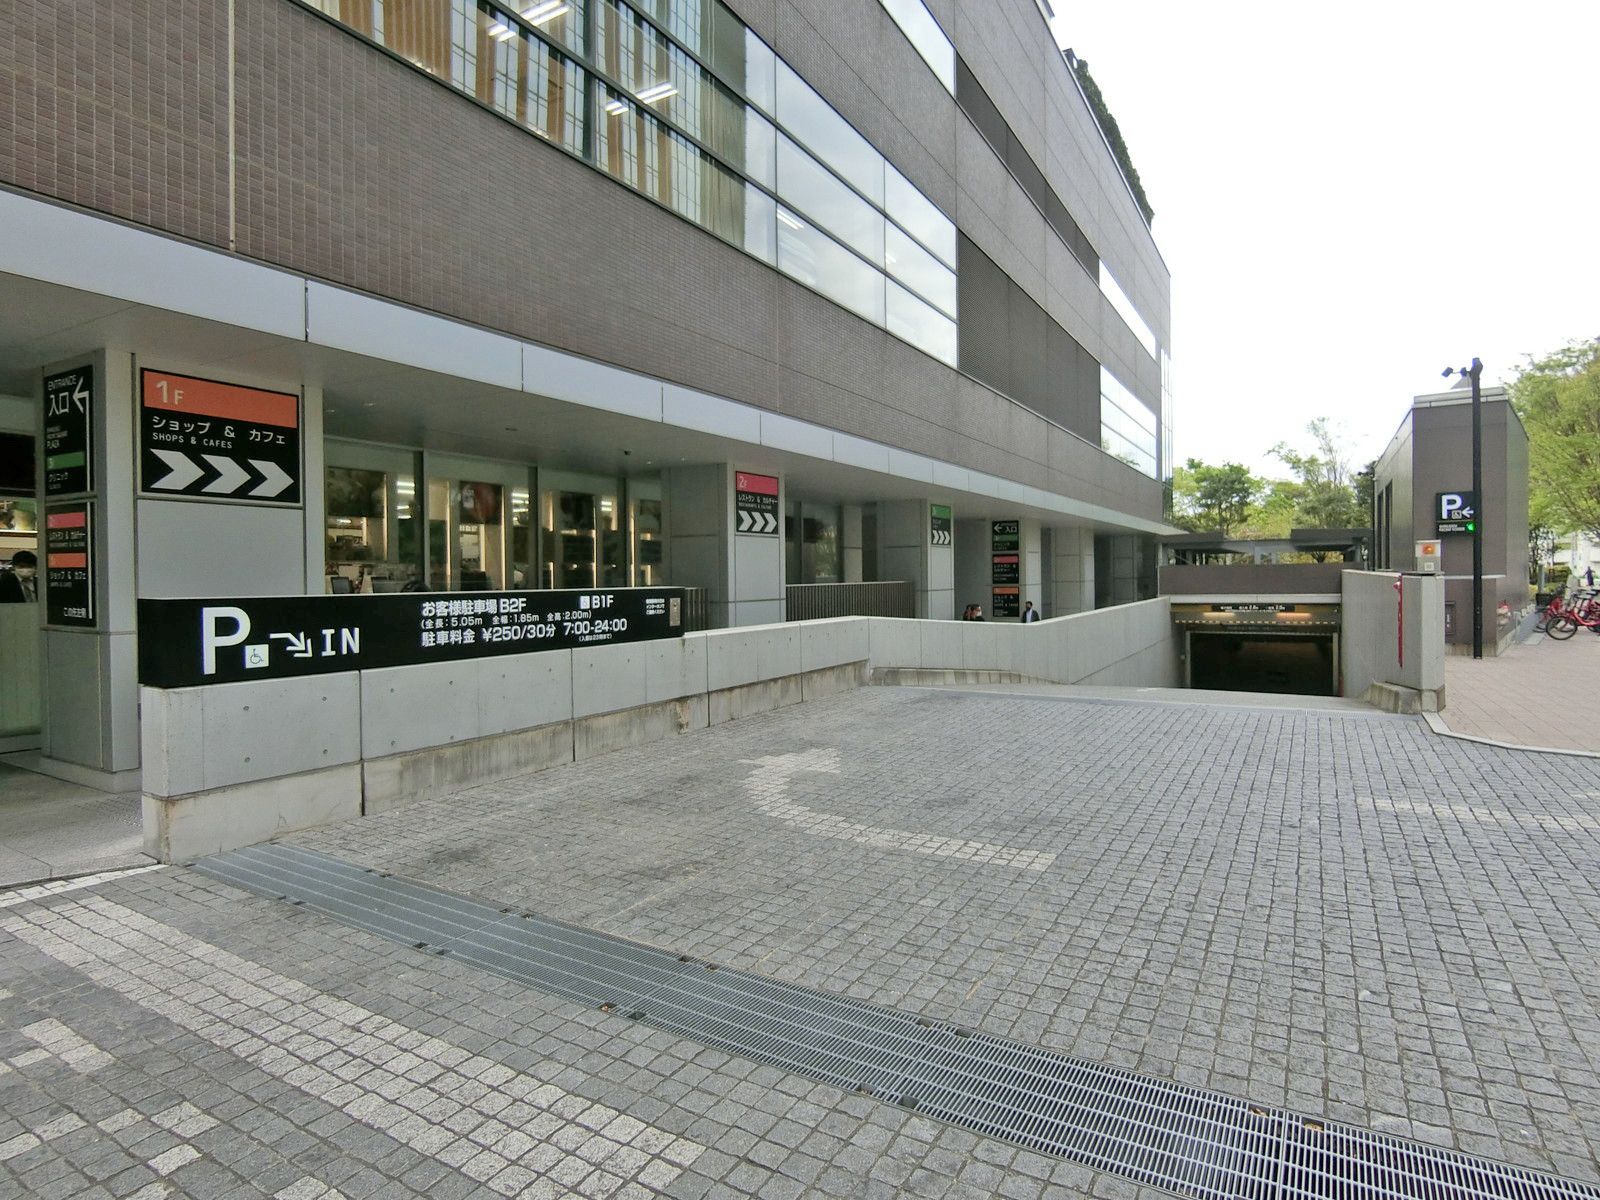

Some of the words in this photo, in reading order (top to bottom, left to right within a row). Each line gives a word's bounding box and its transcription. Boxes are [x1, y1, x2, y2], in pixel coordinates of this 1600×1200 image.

[48, 374, 77, 391] ENTRANCE
[156, 380, 184, 405] 1F
[49, 391, 70, 417] 入口
[152, 416, 211, 434] ショップ
[224, 426, 236, 438] &
[250, 429, 286, 445] カフェ
[152, 432, 185, 443] SHOPS
[190, 437, 197, 445] &
[203, 438, 233, 449] CAFES
[1441, 494, 1463, 519] P
[422, 599, 498, 617] お客様駐車場
[500, 598, 527, 613] B2F
[592, 595, 614, 609] B1F
[202, 606, 251, 675] P
[321, 627, 360, 657] IN
[422, 628, 476, 647] 駐車料金
[482, 623, 557, 642] ¥250/30分
[563, 618, 628, 635] 7:00-24:00
